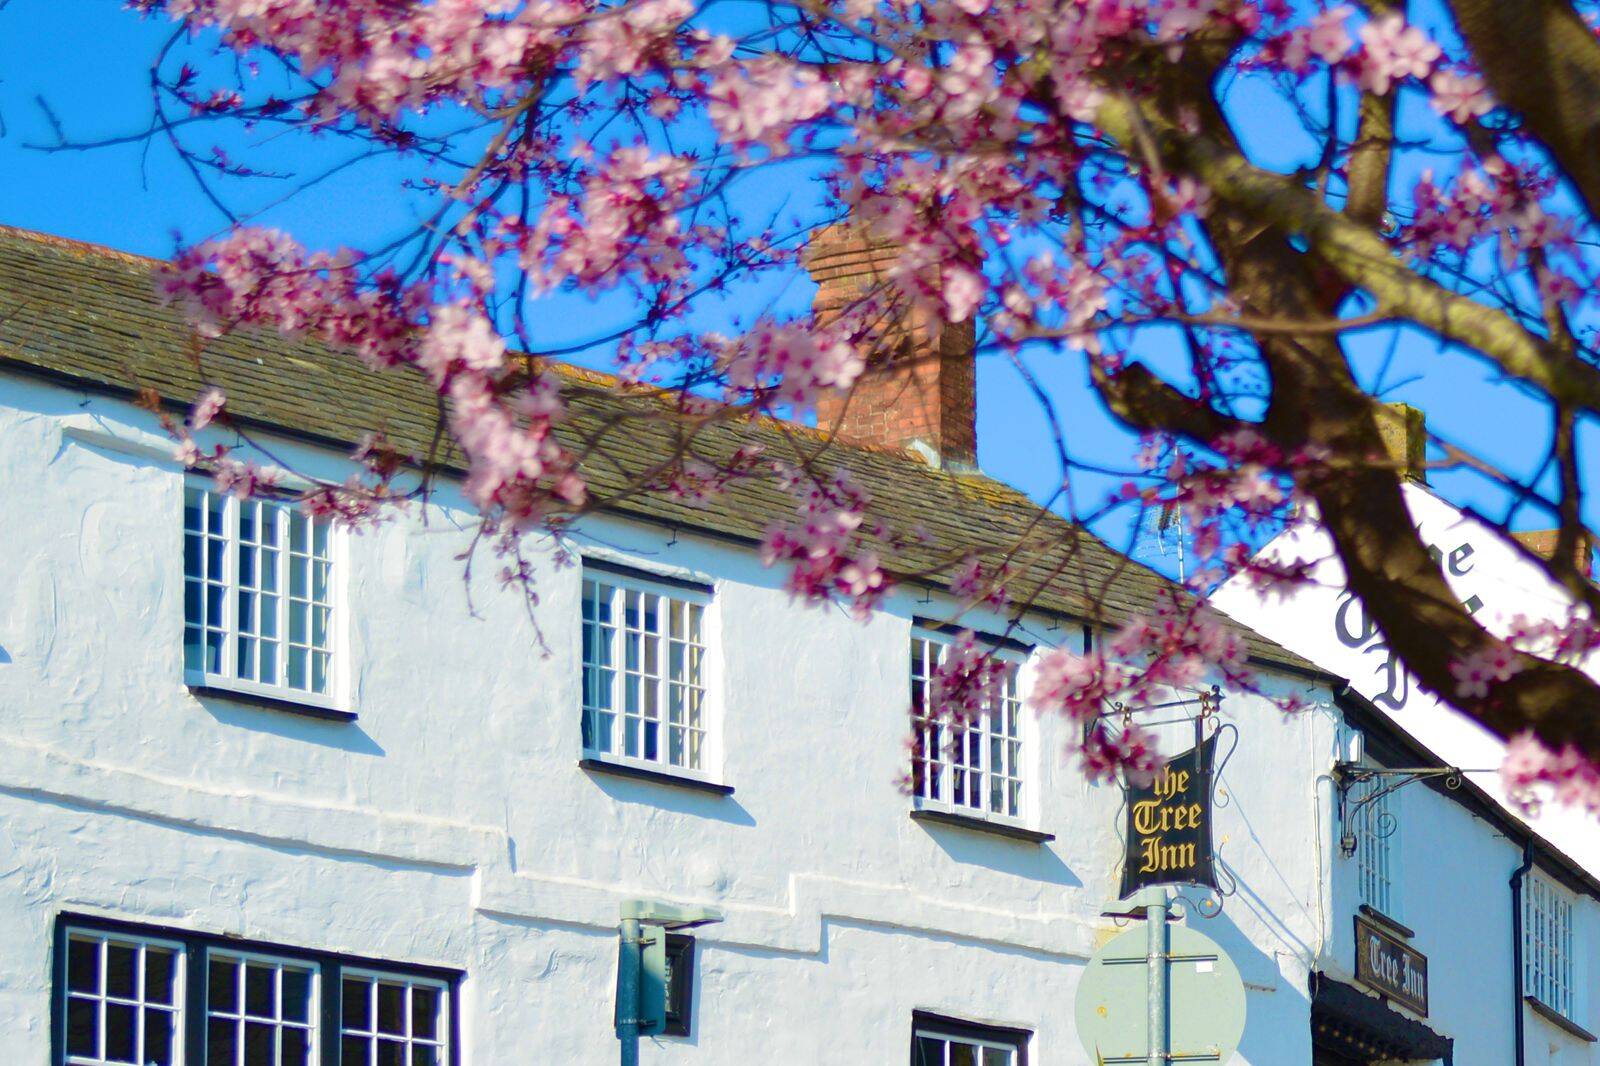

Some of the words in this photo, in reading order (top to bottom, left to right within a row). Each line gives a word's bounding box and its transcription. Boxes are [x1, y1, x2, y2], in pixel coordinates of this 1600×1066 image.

[1132, 799, 1202, 835] Tree
[1139, 836, 1196, 874] Inn
[1369, 935, 1399, 989] Tree
[1402, 952, 1424, 1004] Inn
